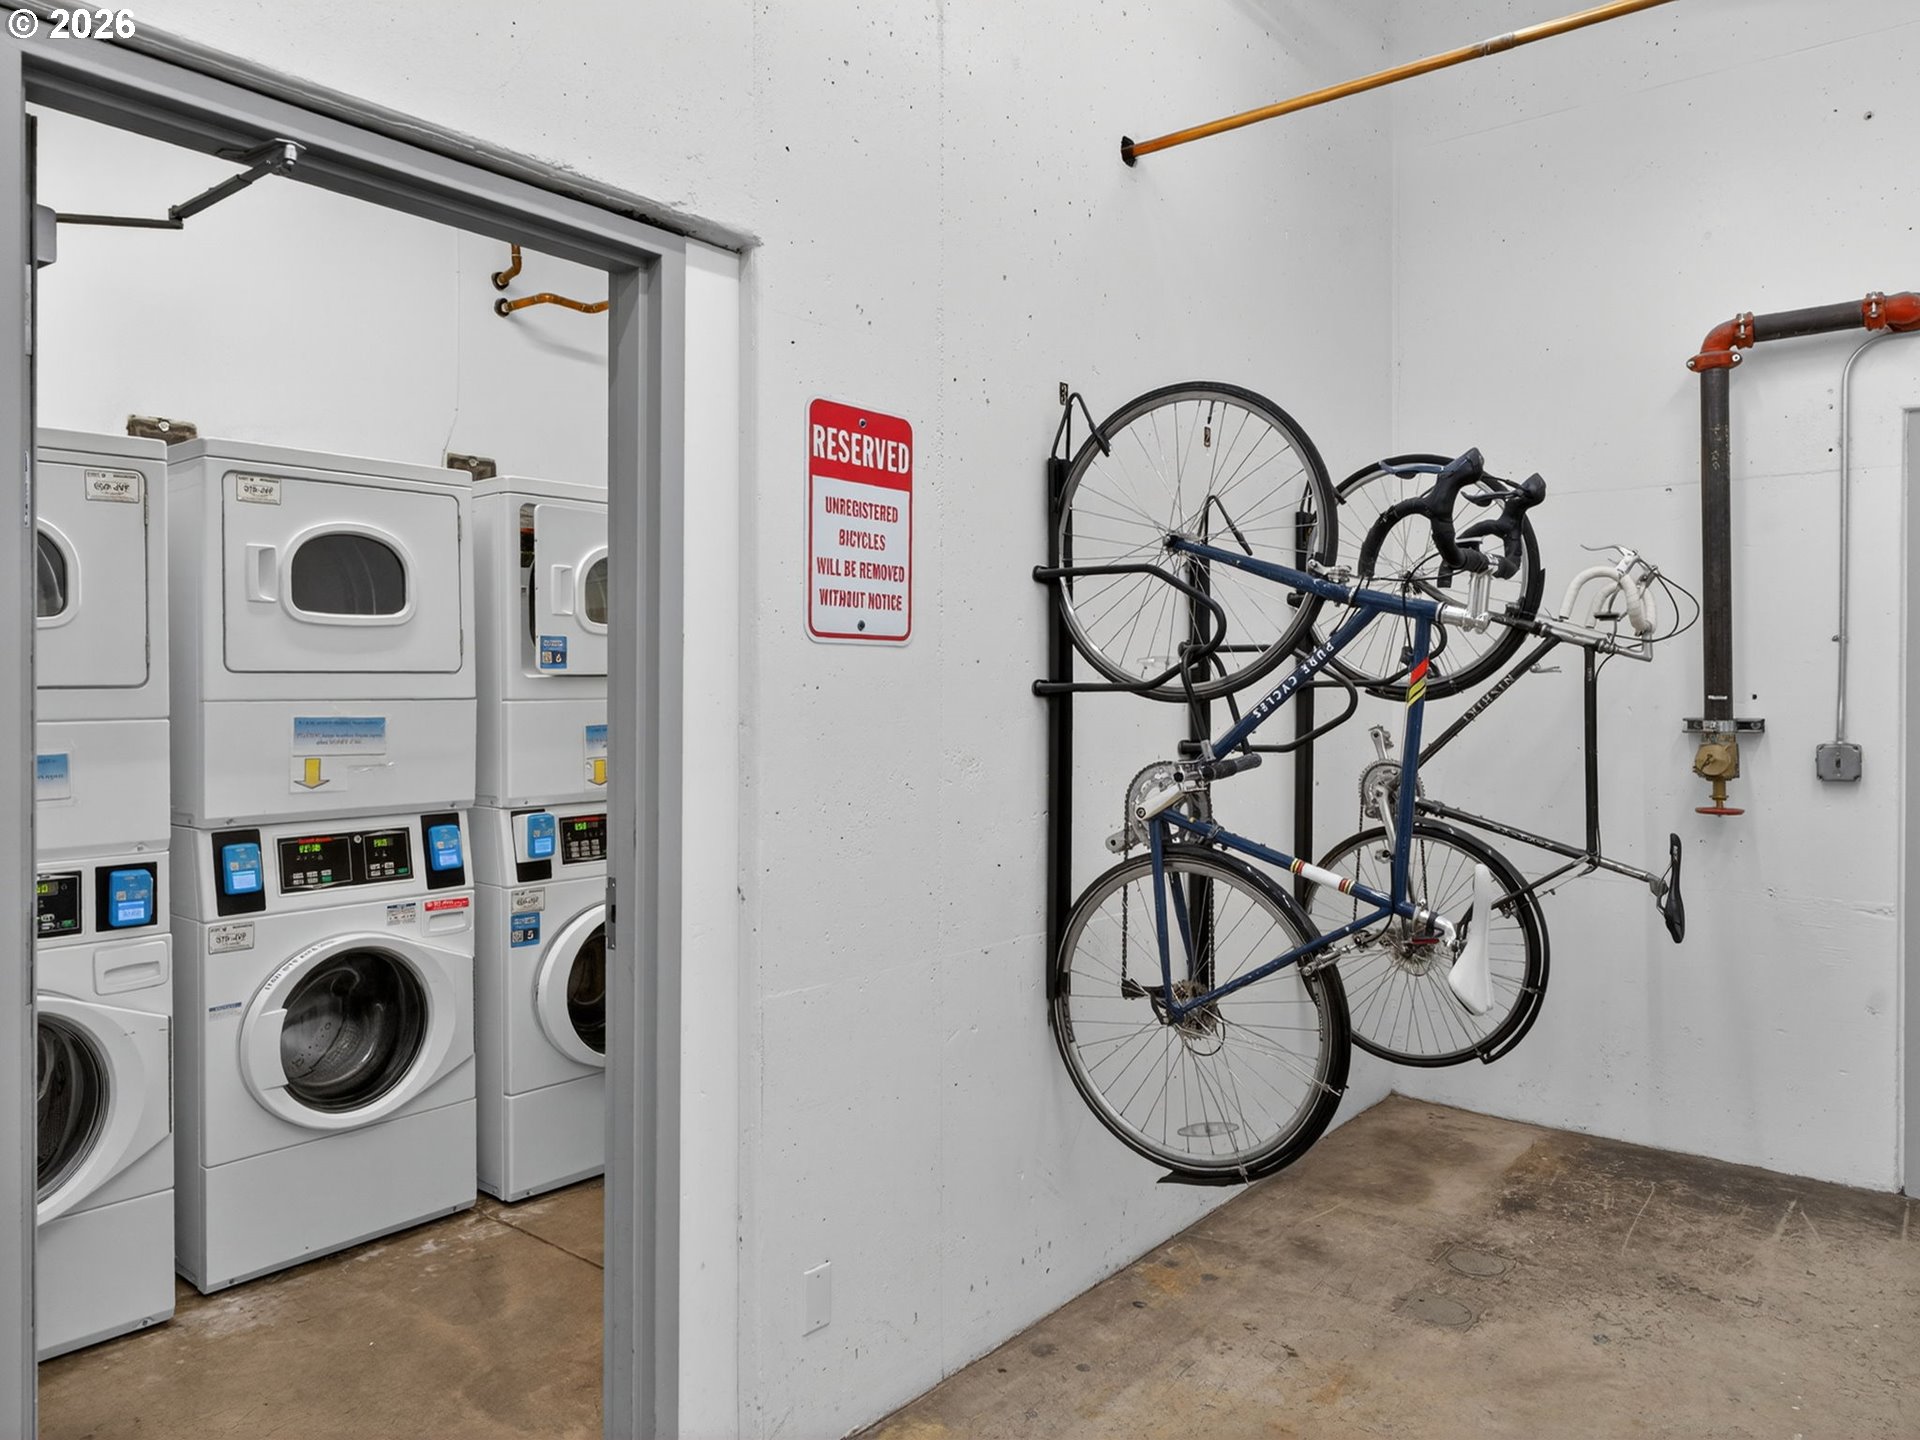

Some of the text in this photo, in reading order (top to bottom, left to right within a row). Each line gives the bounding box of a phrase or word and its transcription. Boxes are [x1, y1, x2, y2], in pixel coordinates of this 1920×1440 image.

[813, 424, 909, 474] RESERVED
[825, 496, 898, 523] UNREGISTERED
[839, 529, 886, 551] BICYCLES
[816, 557, 905, 583] WILL BE REMOVED
[819, 588, 903, 612] WITHOUT NOTICE
[1252, 641, 1335, 718] PURE CYCLES
